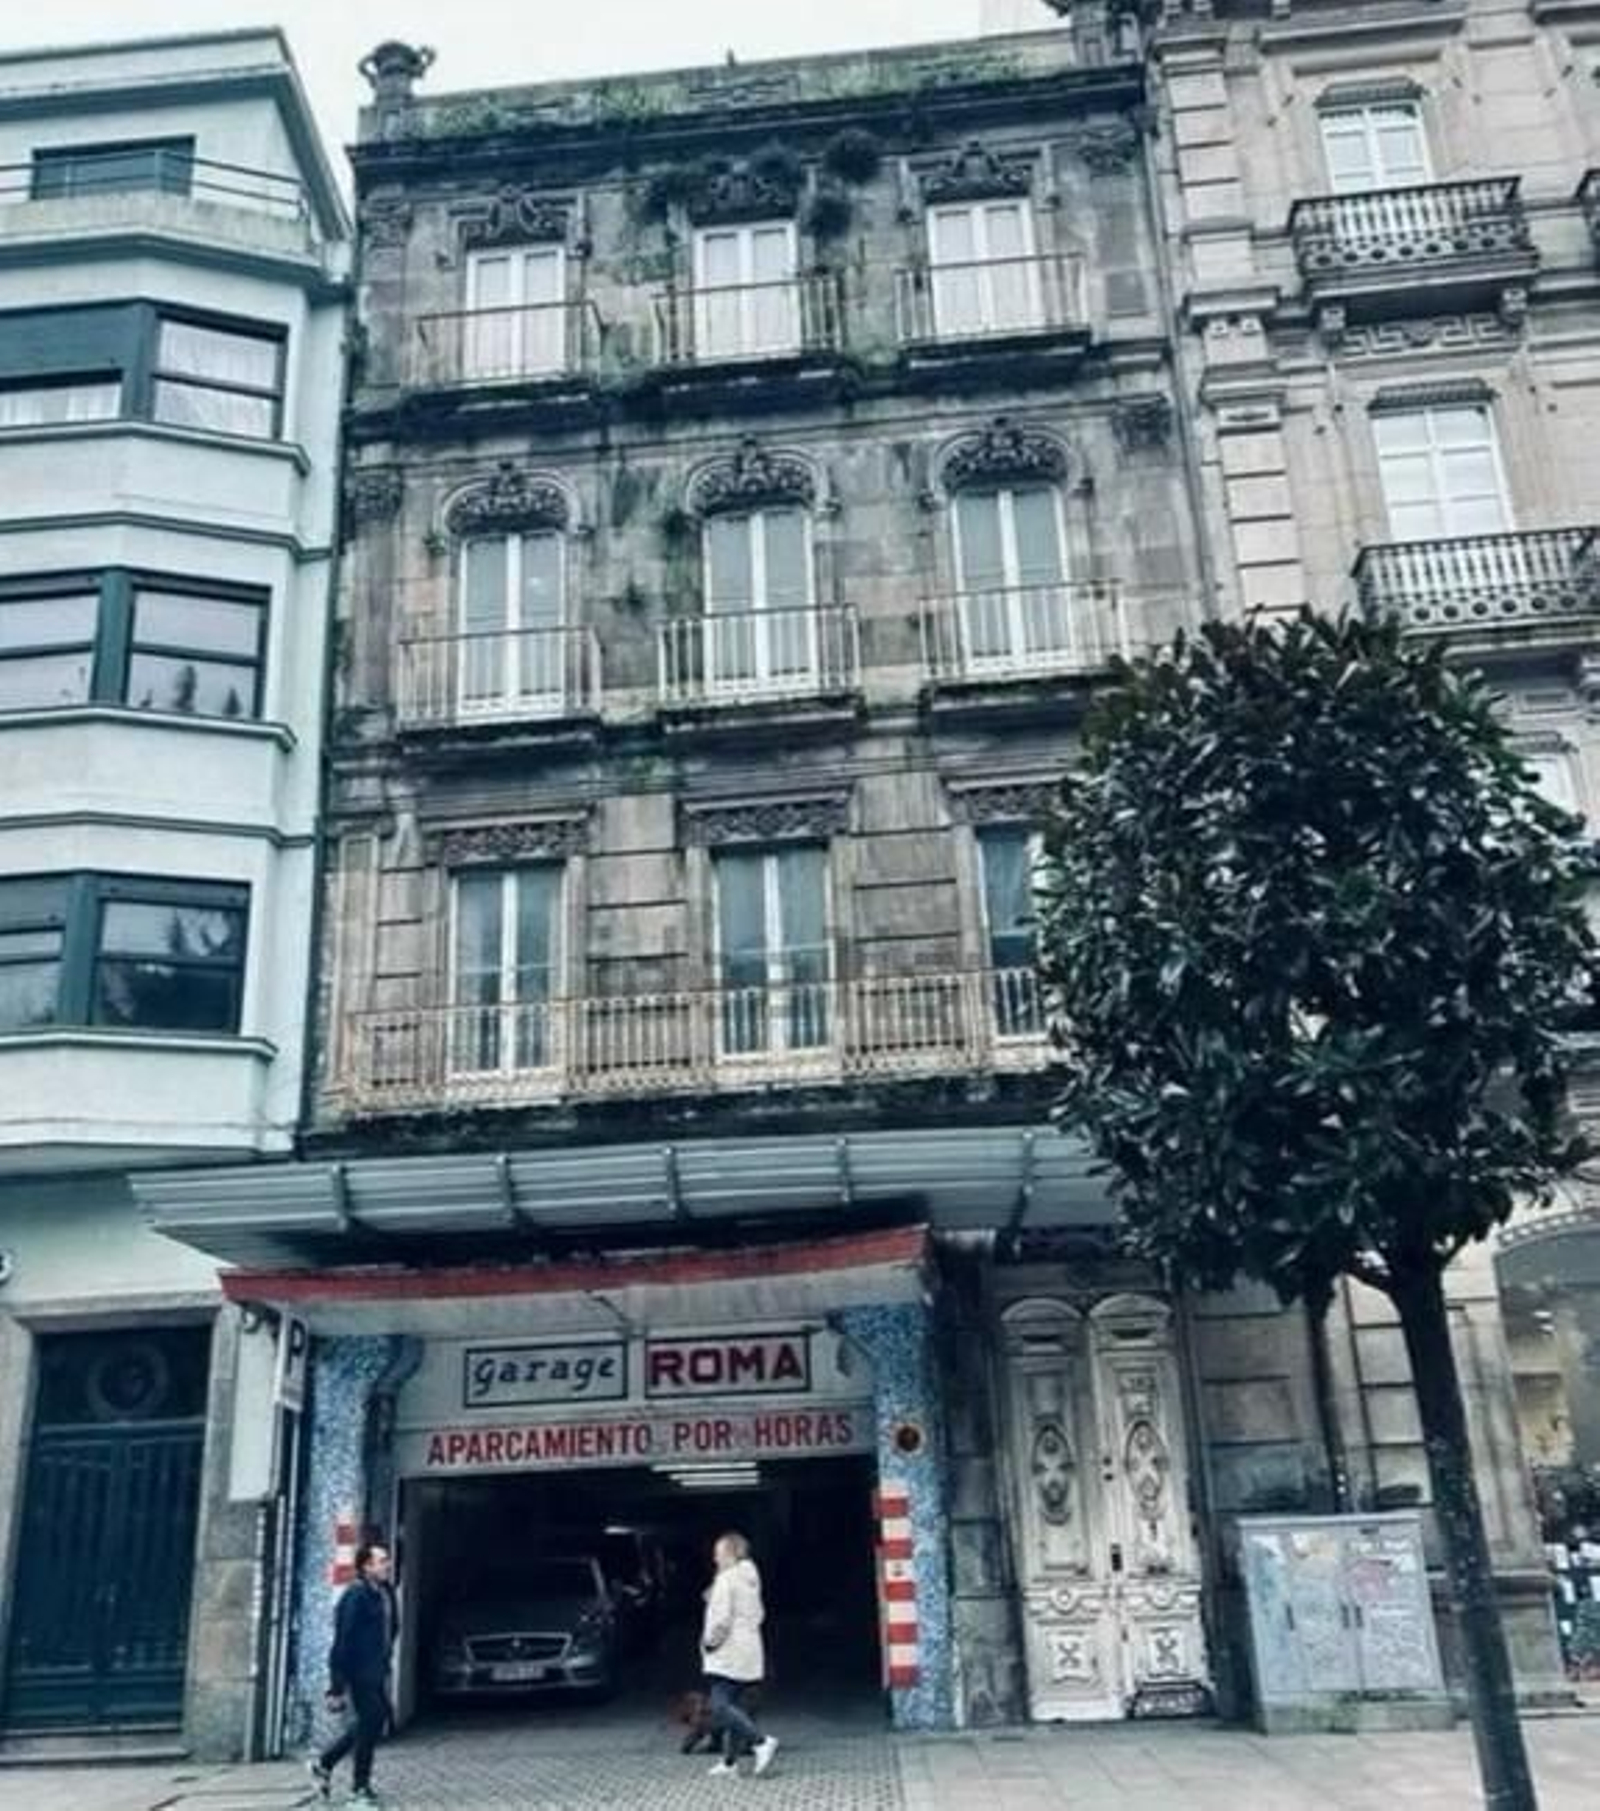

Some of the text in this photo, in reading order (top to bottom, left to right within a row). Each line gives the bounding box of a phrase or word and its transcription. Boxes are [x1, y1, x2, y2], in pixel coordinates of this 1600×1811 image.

[286, 1318, 306, 1376] P
[651, 1343, 803, 1386] ROMA
[427, 1413, 853, 1466] APARCAMIENTO POR HORAS
